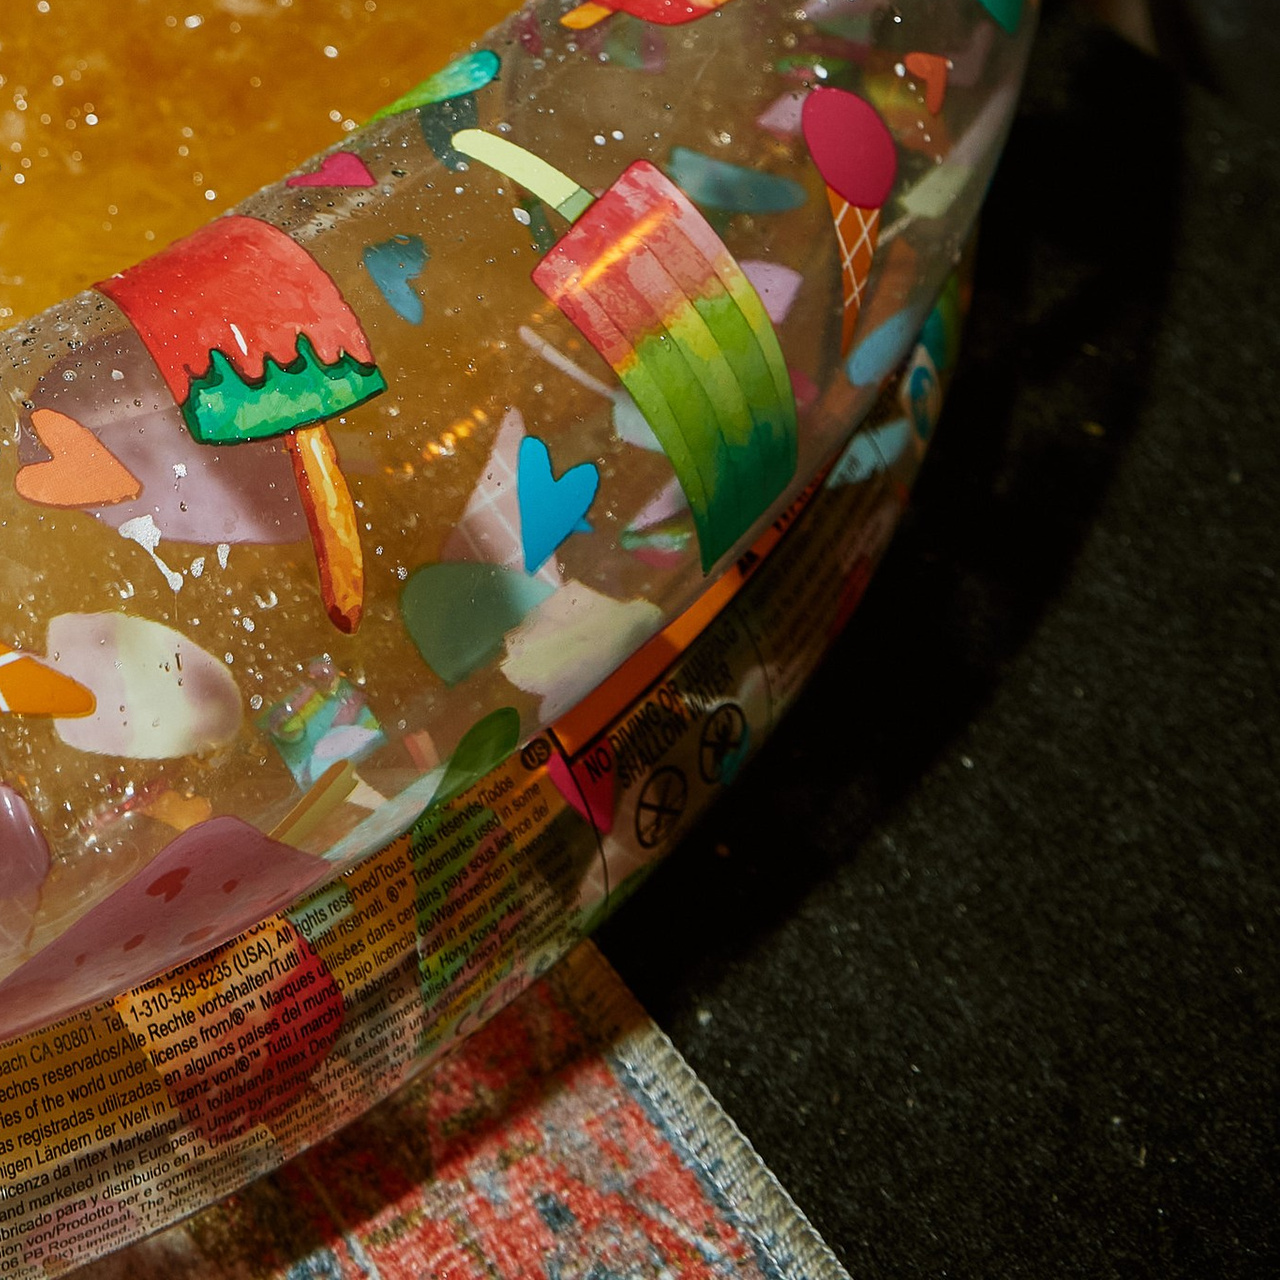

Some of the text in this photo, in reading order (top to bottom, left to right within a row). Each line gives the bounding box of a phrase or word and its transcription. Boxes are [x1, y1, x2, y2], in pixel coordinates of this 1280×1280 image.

[524, 741, 550, 768] US
[583, 747, 611, 783] NO
[608, 701, 661, 757] DIVING
[658, 679, 683, 712] OR
[617, 707, 690, 788] SHALLOW
[24, 1098, 38, 1118] of
[40, 1092, 66, 1112] the
[66, 1072, 106, 1103] world
[109, 1058, 148, 1085] under
[150, 1035, 200, 1068] license
[259, 971, 316, 1012] Marques
[317, 938, 366, 979] utilisées
[367, 920, 396, 946] dans
[469, 847, 496, 874] sous
[29, 1041, 54, 1063] CA
[54, 1025, 102, 1055] 90801.
[103, 1013, 128, 1036] Tel.
[131, 960, 232, 1023] 1-310-549-8235
[233, 940, 276, 974] (USA).
[276, 926, 294, 949] All
[296, 908, 328, 938] rights
[328, 859, 406, 917] reserved/Tous
[42, 1031, 146, 1086] reservados/Alle
[150, 1008, 196, 1041] Rechte
[197, 947, 300, 1019] vorbehalten/Tutti
[338, 896, 388, 936] riservati.
[512, 785, 540, 812] some
[17, 1106, 96, 1145] registradas
[97, 1076, 162, 1116] utilizadas
[164, 1067, 182, 1085] en
[183, 1042, 236, 1076] algunos
[237, 1020, 280, 1055] países
[281, 1000, 302, 1027] del
[304, 982, 346, 1012] mundo
[346, 963, 374, 989] bajo
[373, 932, 416, 971] licencia
[35, 1134, 92, 1163] Ländern
[94, 1124, 118, 1143] der
[119, 1106, 150, 1133] Welt
[168, 1077, 210, 1108] Lizenz
[263, 1031, 292, 1058] Tutti
[301, 1002, 342, 1038] marchi
[0, 1174, 50, 1201] licenza
[52, 1164, 70, 1181] da
[73, 1149, 108, 1172] Intex
[110, 1119, 178, 1156] Marketing
[179, 1105, 204, 1127] Ltd.
[28, 1173, 94, 1212] marketed
[112, 1159, 136, 1177] the
[138, 1126, 204, 1164] European
[207, 1105, 246, 1129] Union
[56, 1153, 190, 1222] para distribuido en
[118, 1195, 140, 1213] per
[156, 1131, 268, 1193] commercializzato
[48, 1215, 134, 1254] Roosendaal,
